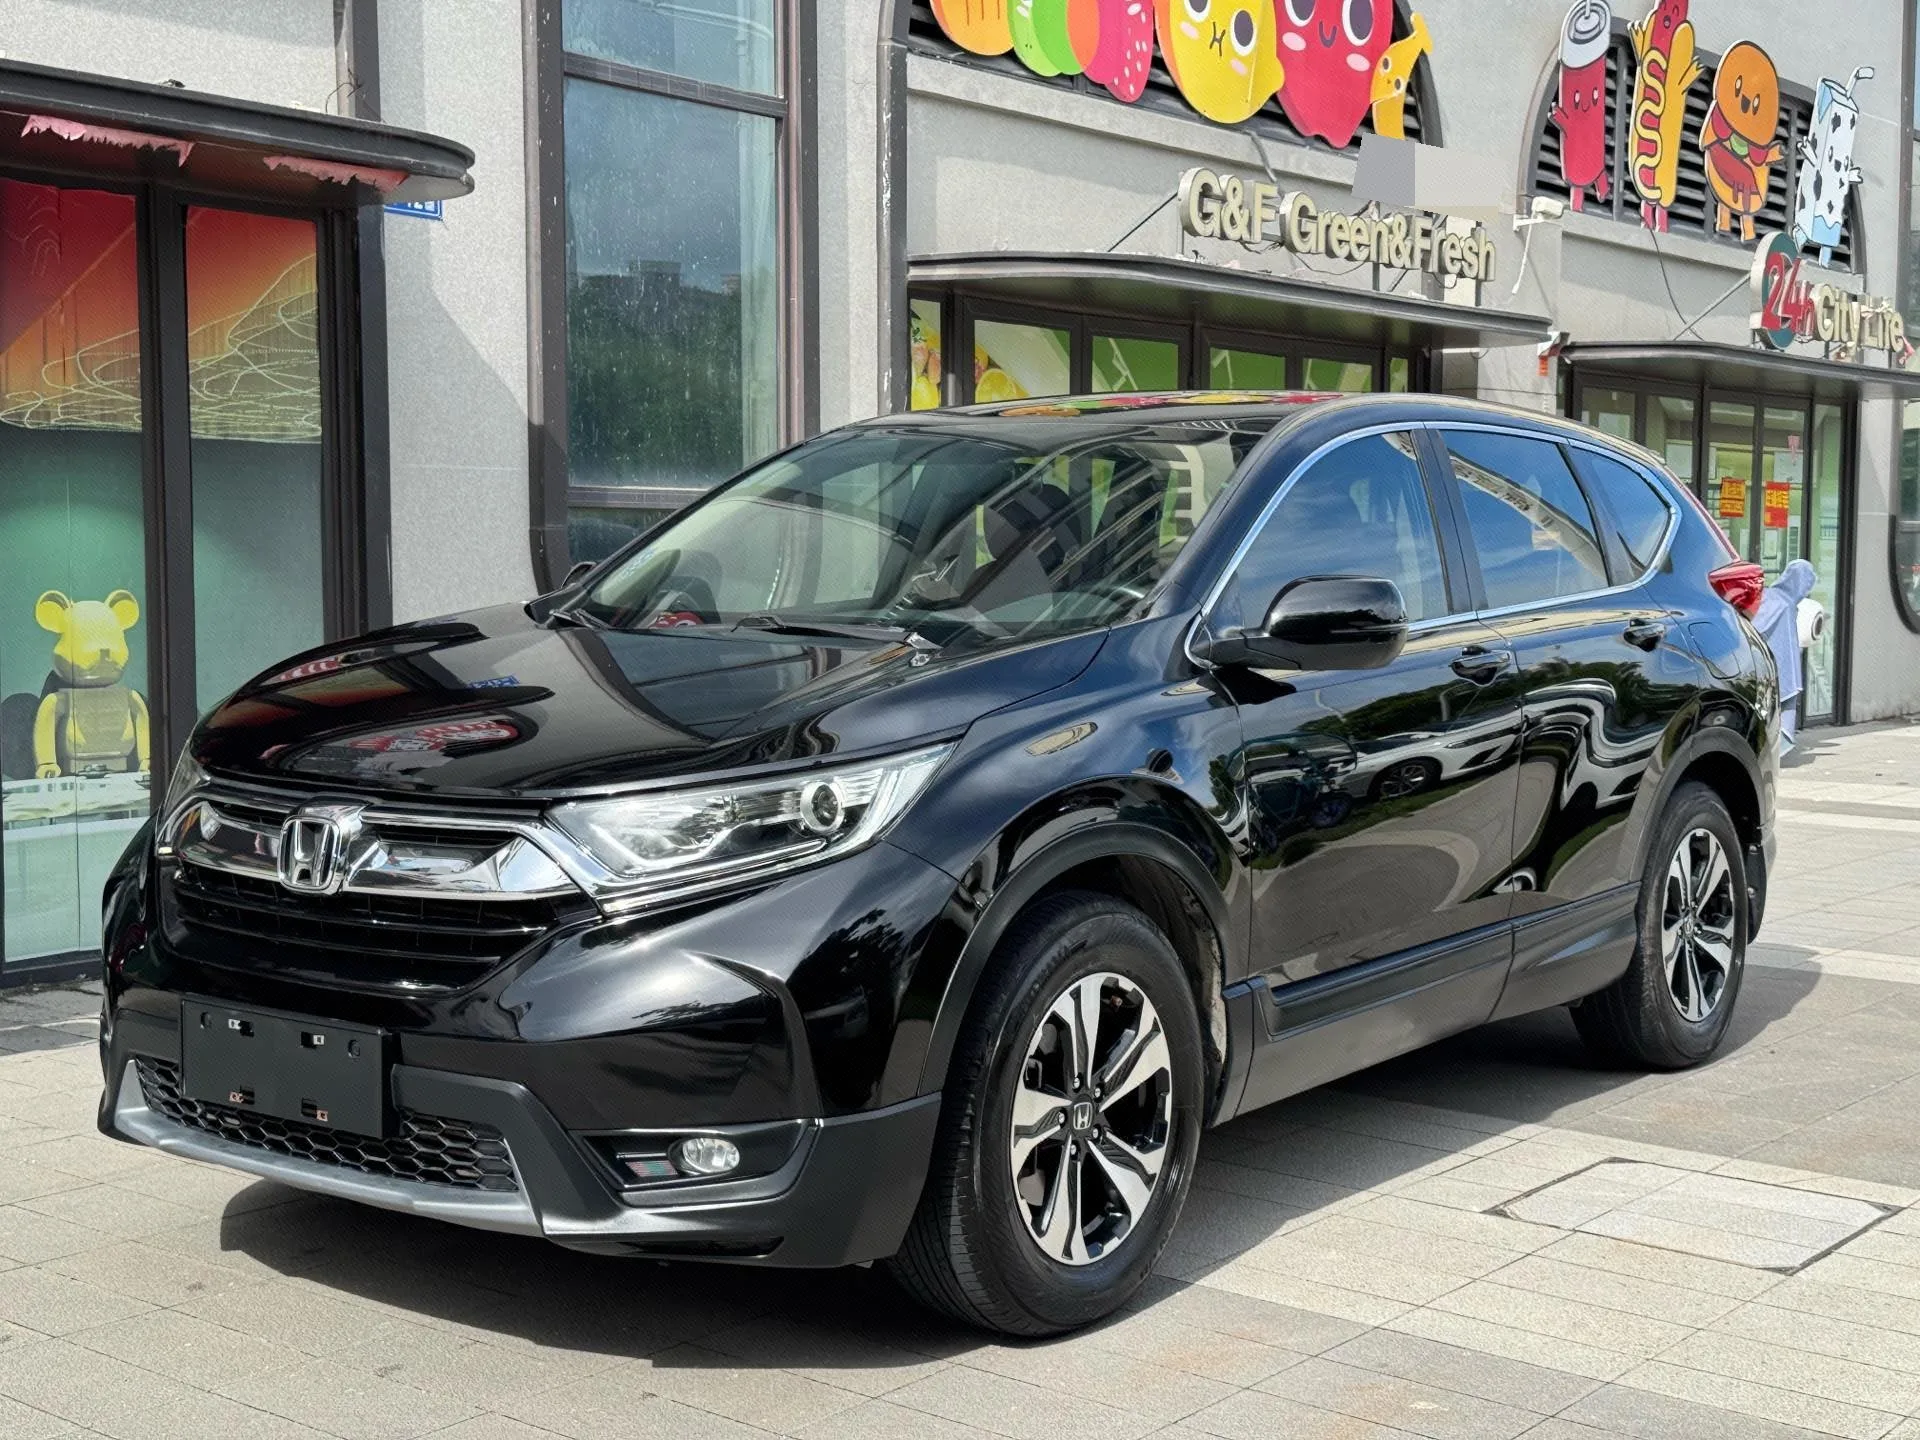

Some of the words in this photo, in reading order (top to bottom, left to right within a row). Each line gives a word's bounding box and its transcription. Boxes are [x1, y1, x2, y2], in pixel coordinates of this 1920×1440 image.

[1182, 168, 1278, 243] G&F
[1283, 192, 1496, 281] Green&Fresh
[1761, 252, 1815, 340] 24h
